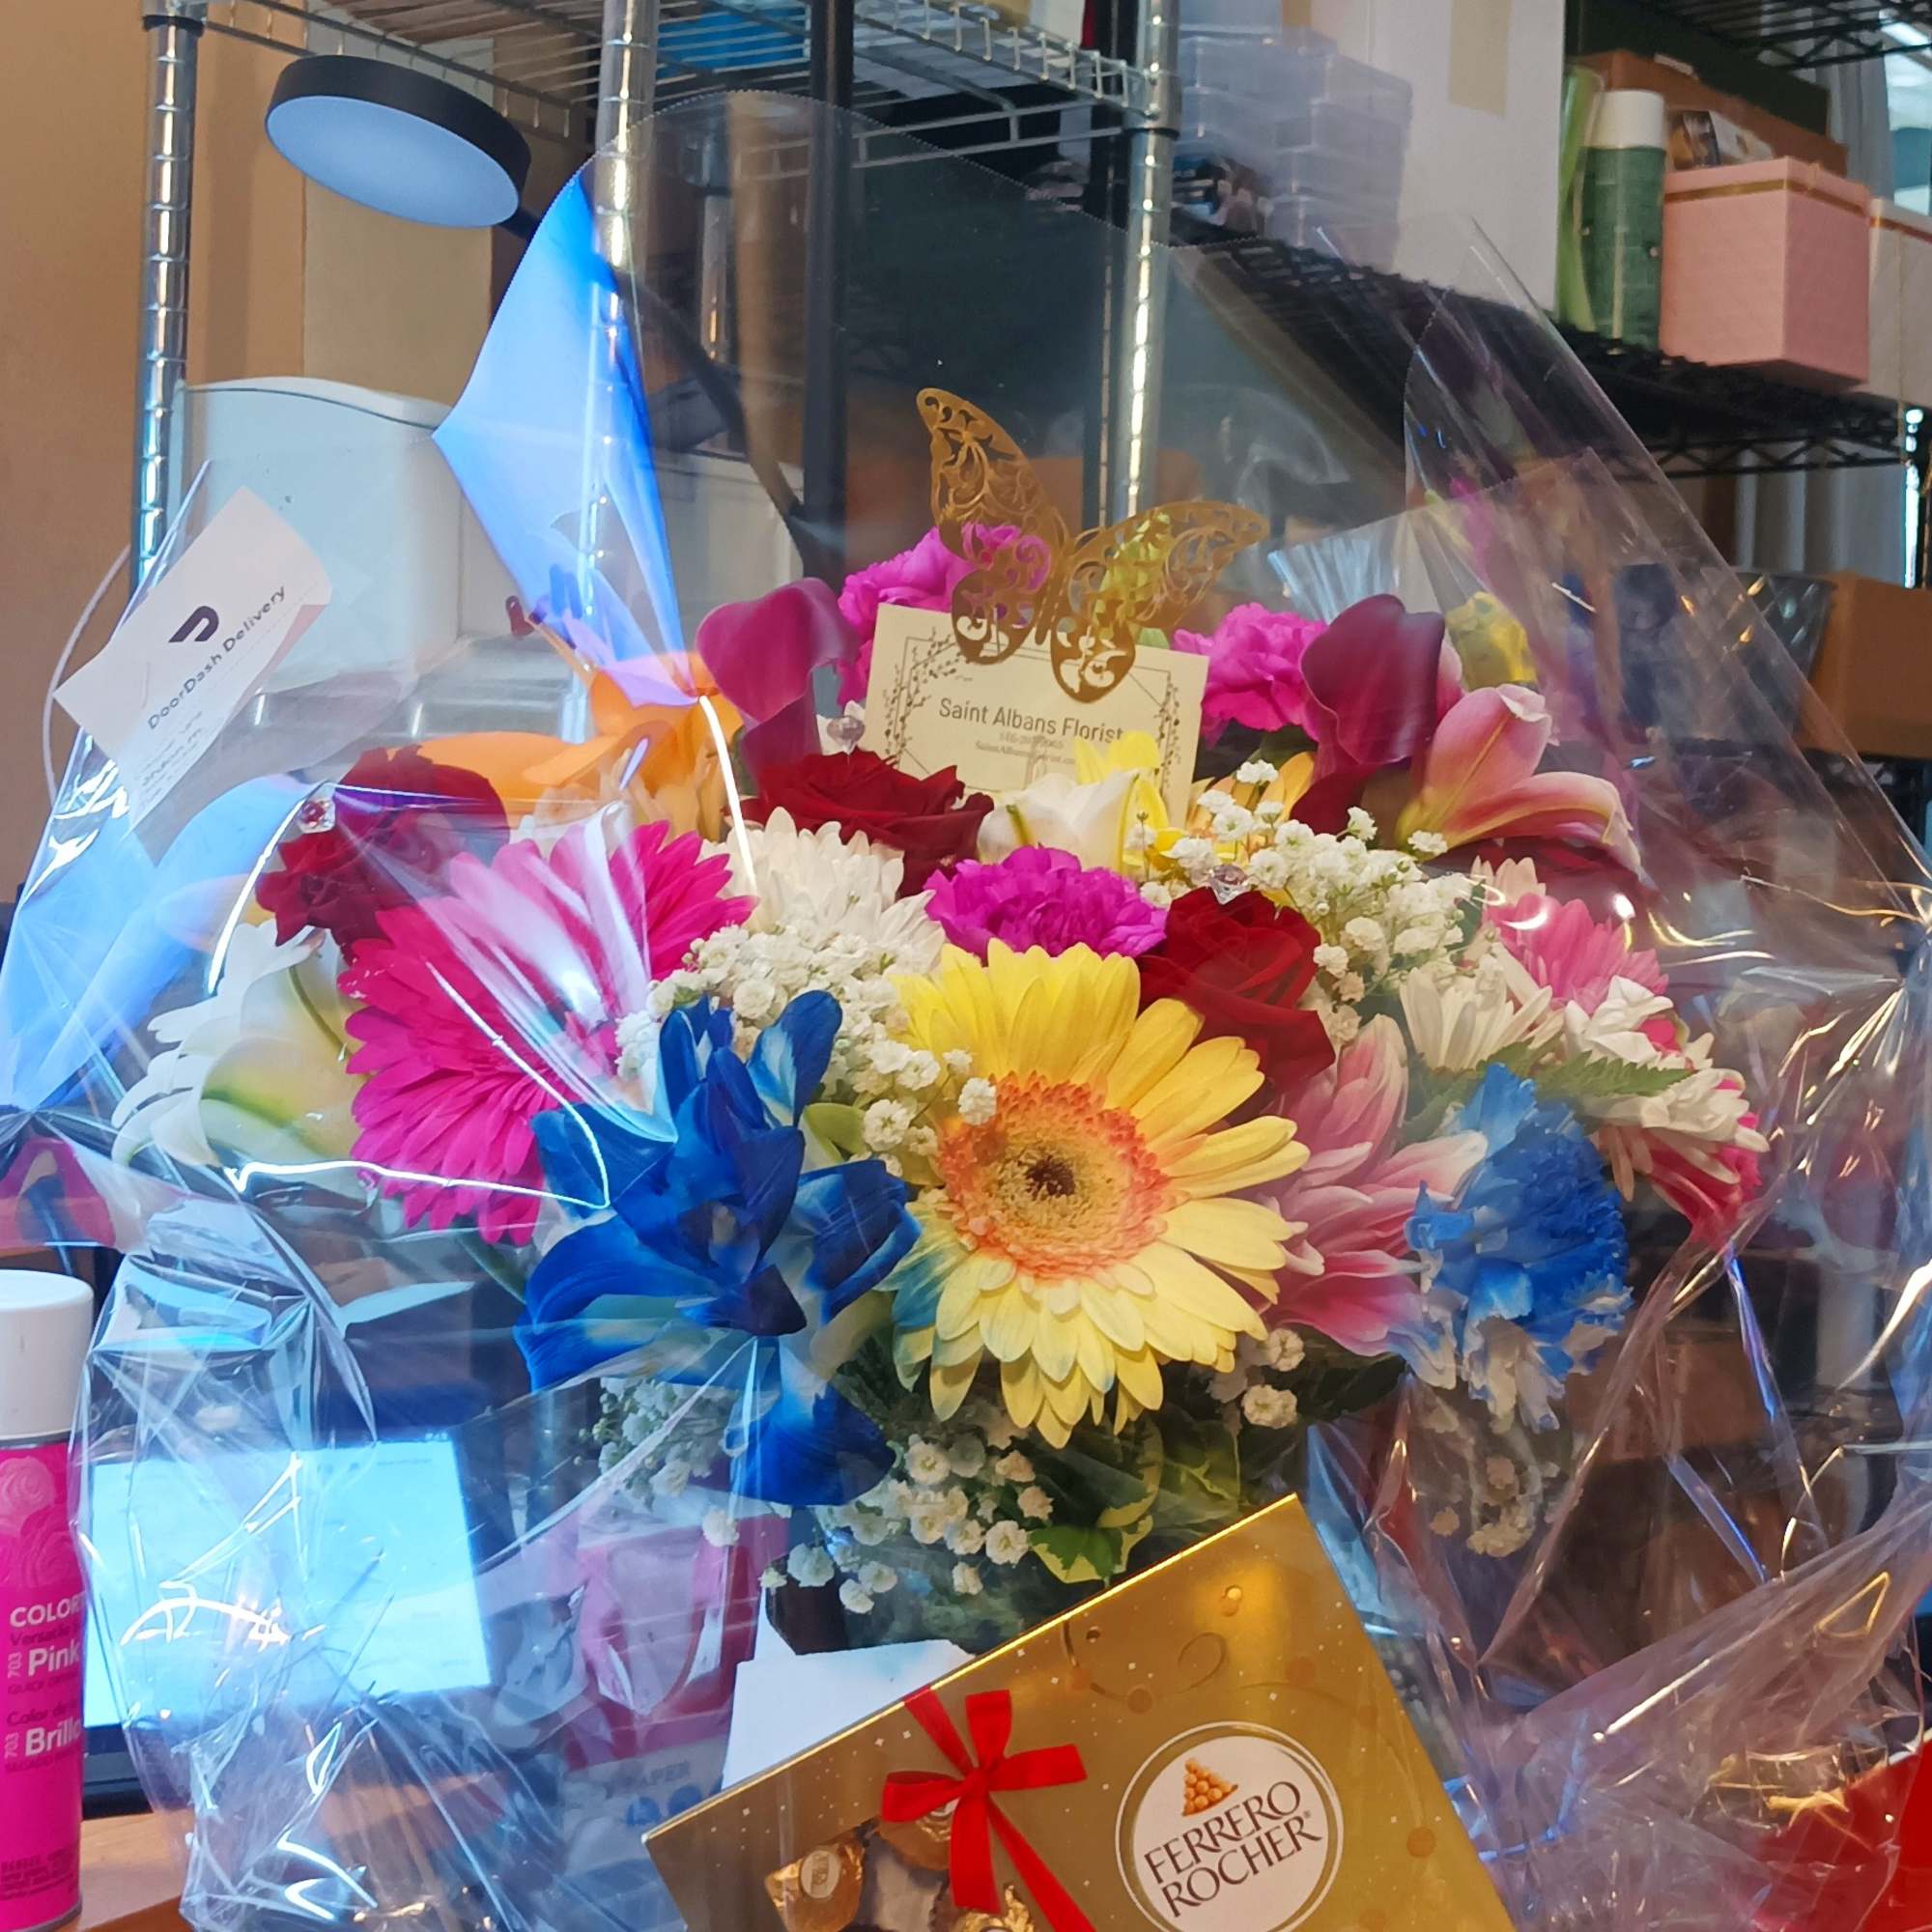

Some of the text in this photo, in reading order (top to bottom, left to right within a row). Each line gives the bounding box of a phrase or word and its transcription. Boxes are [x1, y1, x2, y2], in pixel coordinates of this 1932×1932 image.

[148, 653, 222, 729] DoorDash
[223, 584, 286, 652] Delivery
[939, 697, 989, 724] Saint
[992, 706, 1057, 735] Albans
[1063, 718, 1123, 744] Florist
[28, 1638, 80, 1677] Pink
[1144, 1781, 1300, 1884] FERRERO
[1161, 1815, 1321, 1918] ROCHER
